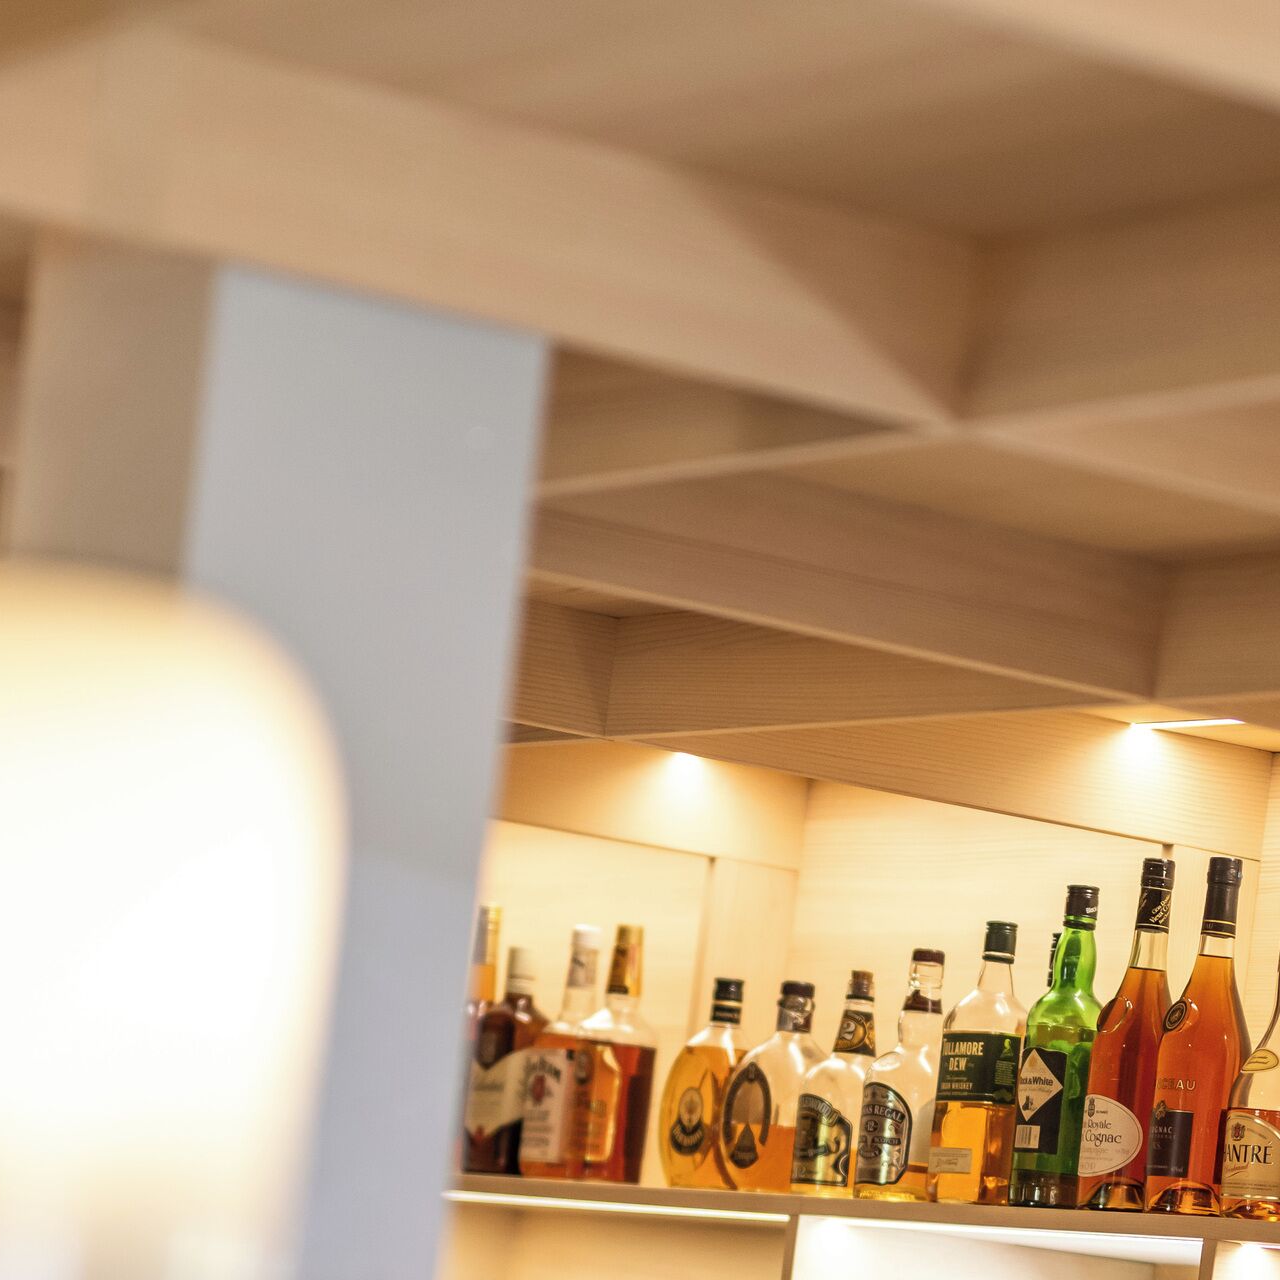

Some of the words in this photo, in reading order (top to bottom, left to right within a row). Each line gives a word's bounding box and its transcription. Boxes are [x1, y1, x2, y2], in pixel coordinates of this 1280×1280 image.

[948, 1057, 968, 1071] DEW
[874, 1104, 902, 1121] REGAL
[1087, 1118, 1112, 1130] Royale
[1085, 1129, 1122, 1148] Cognac
